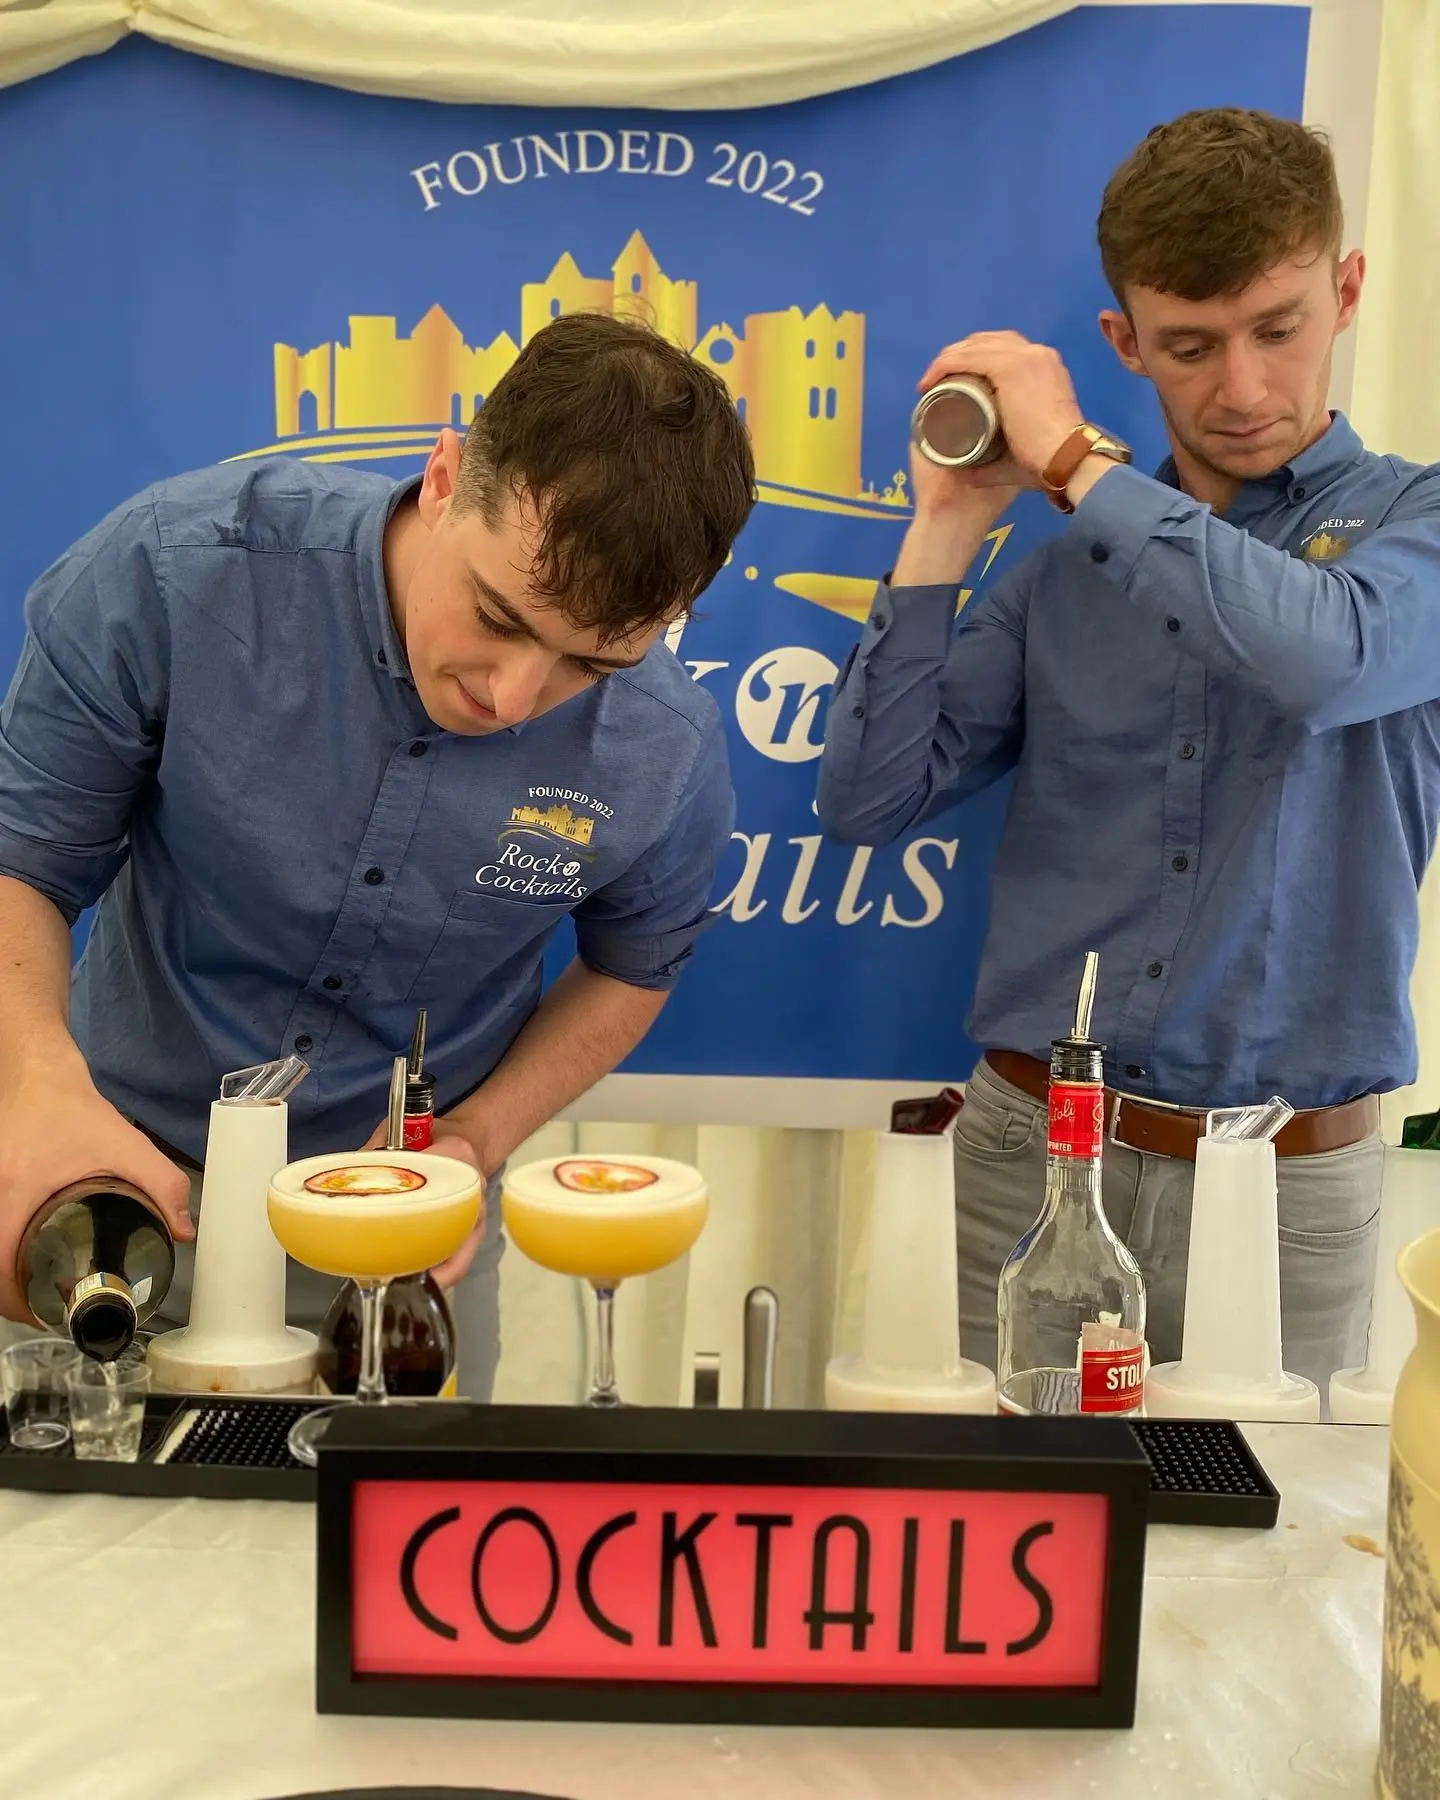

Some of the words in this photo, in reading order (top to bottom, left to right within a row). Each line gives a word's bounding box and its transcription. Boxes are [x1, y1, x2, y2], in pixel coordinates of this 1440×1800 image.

[410, 129, 695, 211] FOUNDED
[706, 142, 825, 216] 2022
[528, 786, 589, 804] FOUNDED
[589, 798, 615, 820] 2022
[496, 842, 565, 875] Rock
[475, 864, 588, 898] Cocktails
[1106, 1361, 1143, 1390] STOL
[400, 1504, 1054, 1657] COCKTAILS
